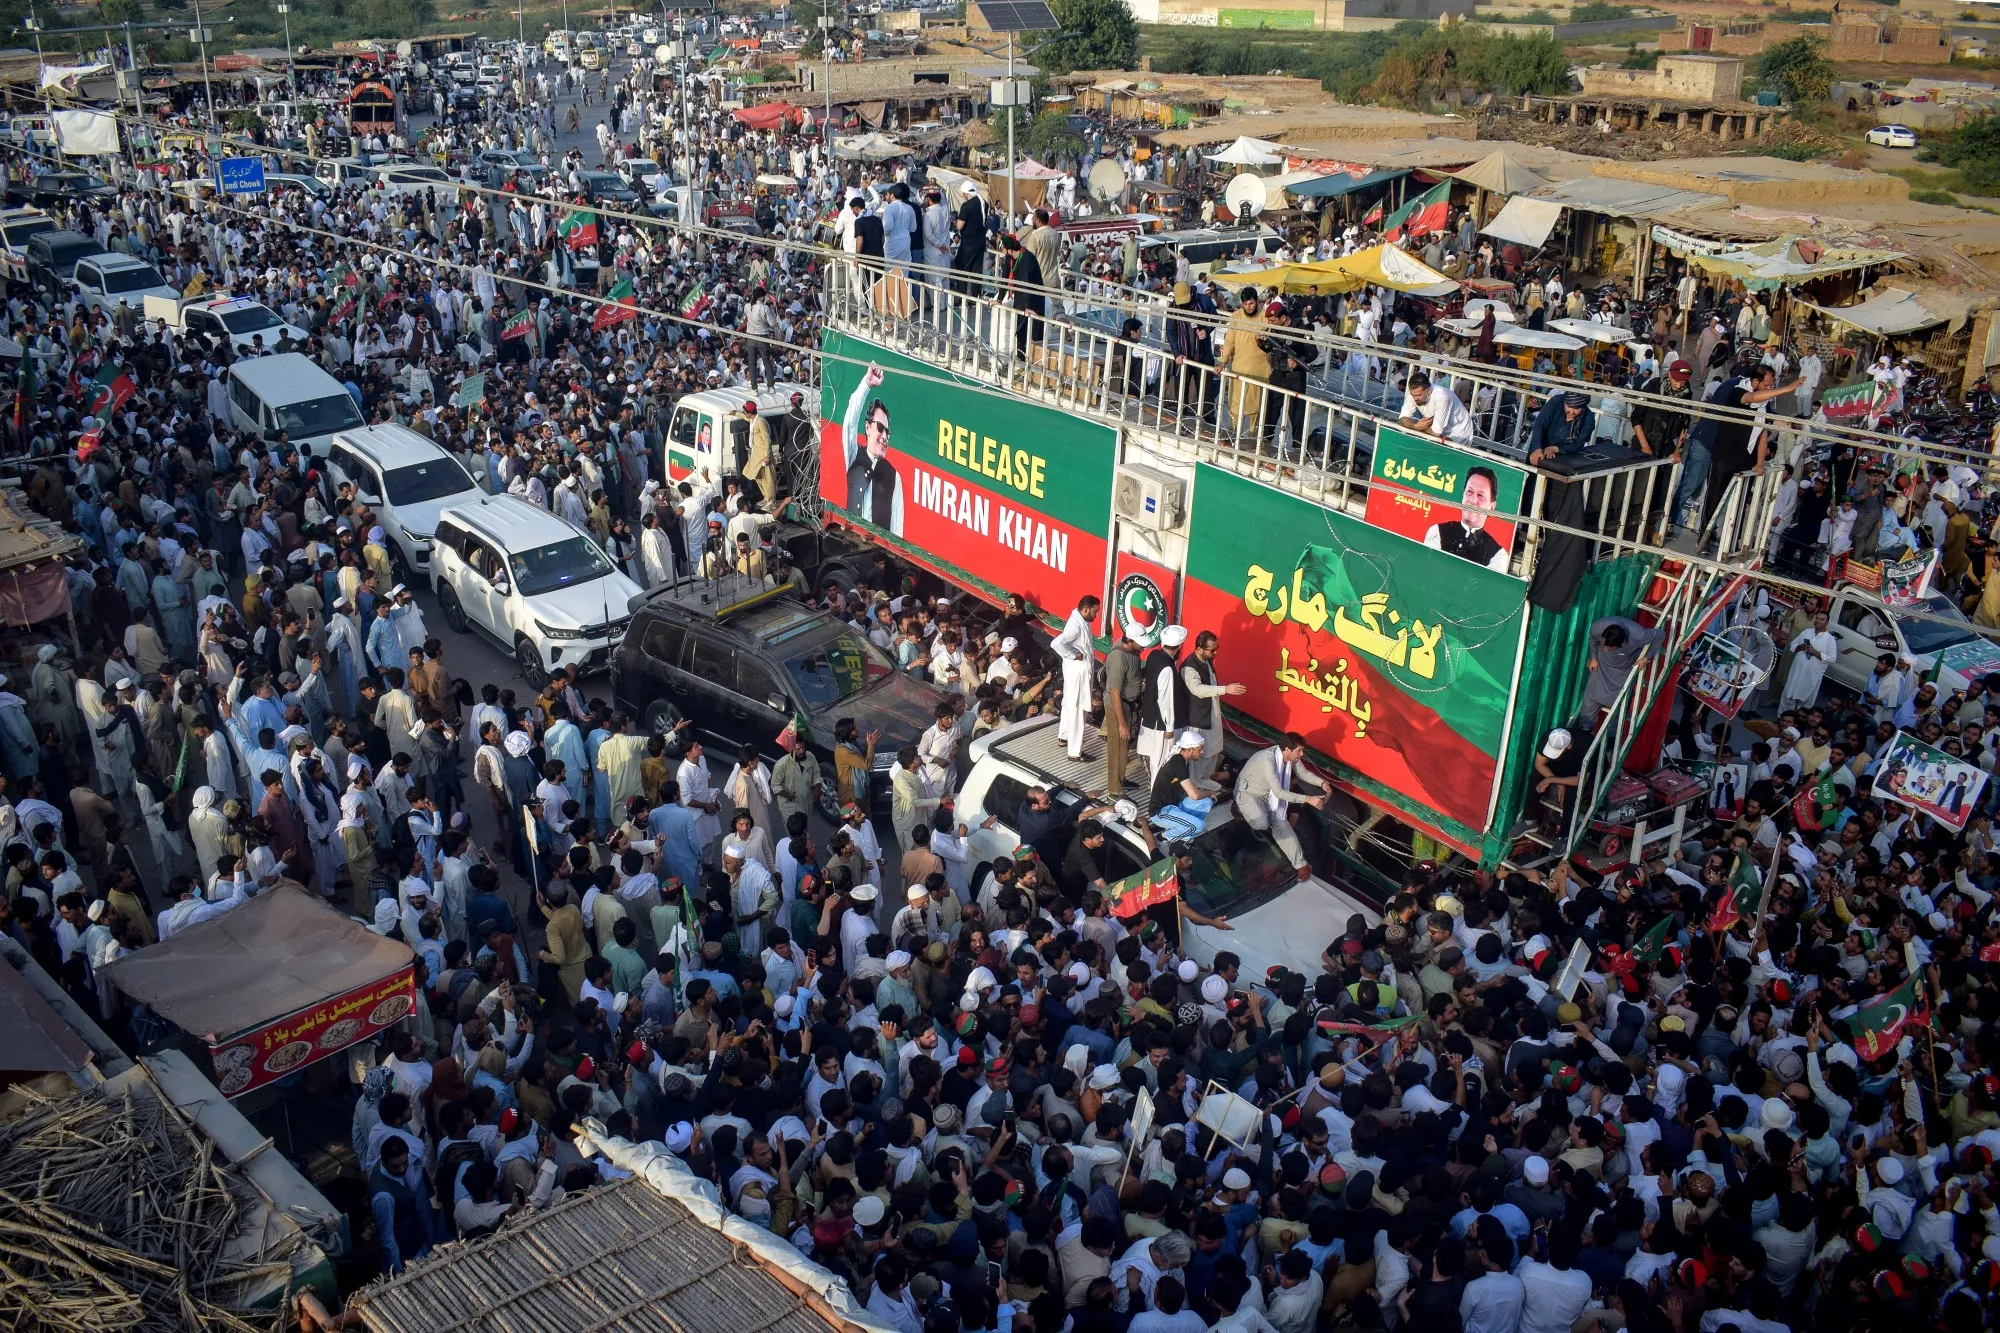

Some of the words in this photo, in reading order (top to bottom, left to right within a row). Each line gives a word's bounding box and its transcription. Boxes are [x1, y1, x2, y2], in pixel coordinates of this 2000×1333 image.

[224, 180, 239, 190] andi
[239, 179, 261, 189] Chowk
[937, 418, 1046, 499] RELEASE
[1383, 458, 1416, 481] مارچ
[1417, 465, 1457, 494] لانگ
[913, 467, 990, 537] IMRAN
[998, 505, 1069, 573] KHAN
[1244, 564, 1329, 632] مارچ
[1117, 604, 1129, 628] Pakist
[1334, 592, 1443, 680] لانگ
[329, 992, 374, 1021] سپیشل
[291, 1009, 328, 1037] کابلی
